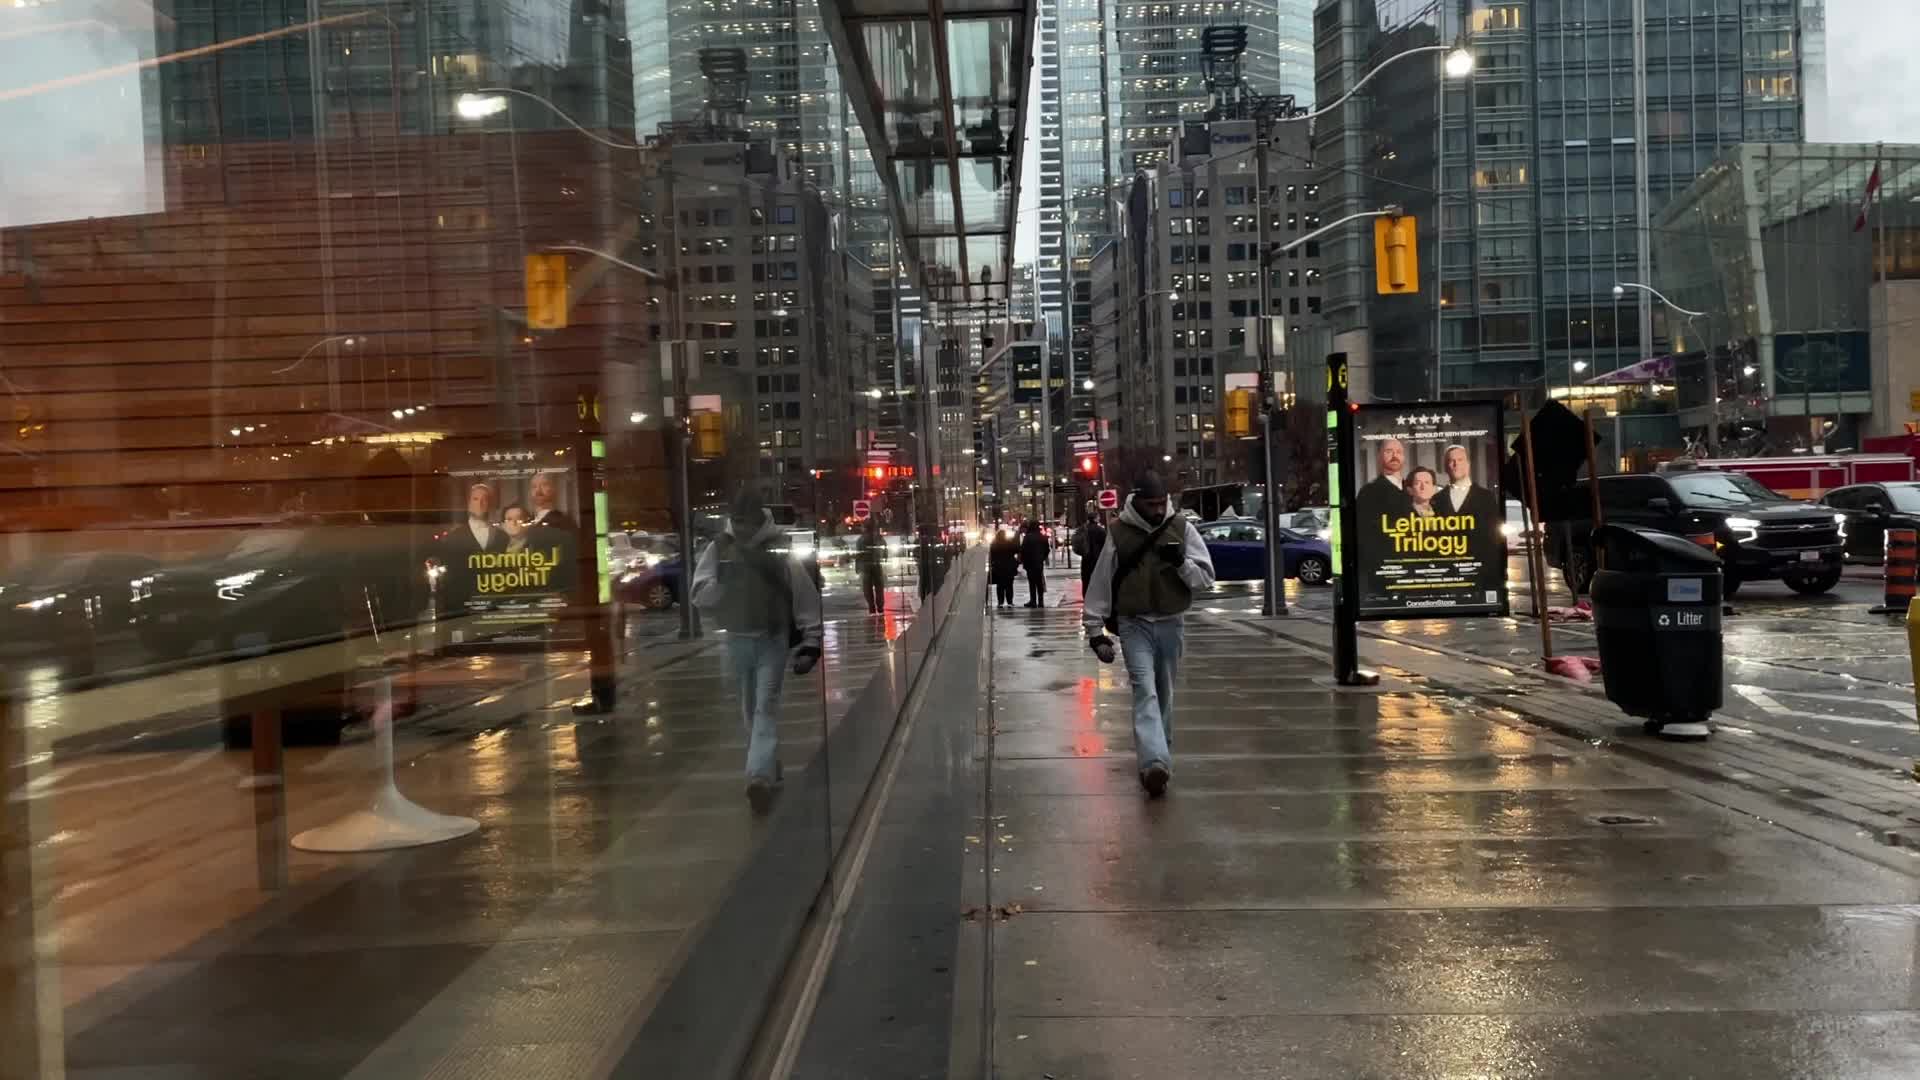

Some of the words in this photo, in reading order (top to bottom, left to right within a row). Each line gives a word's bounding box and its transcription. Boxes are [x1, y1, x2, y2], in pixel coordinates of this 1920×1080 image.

[1382, 512, 1475, 533] Lehman
[1389, 531, 1467, 555] Trilogy
[1677, 611, 1704, 625] Litter
